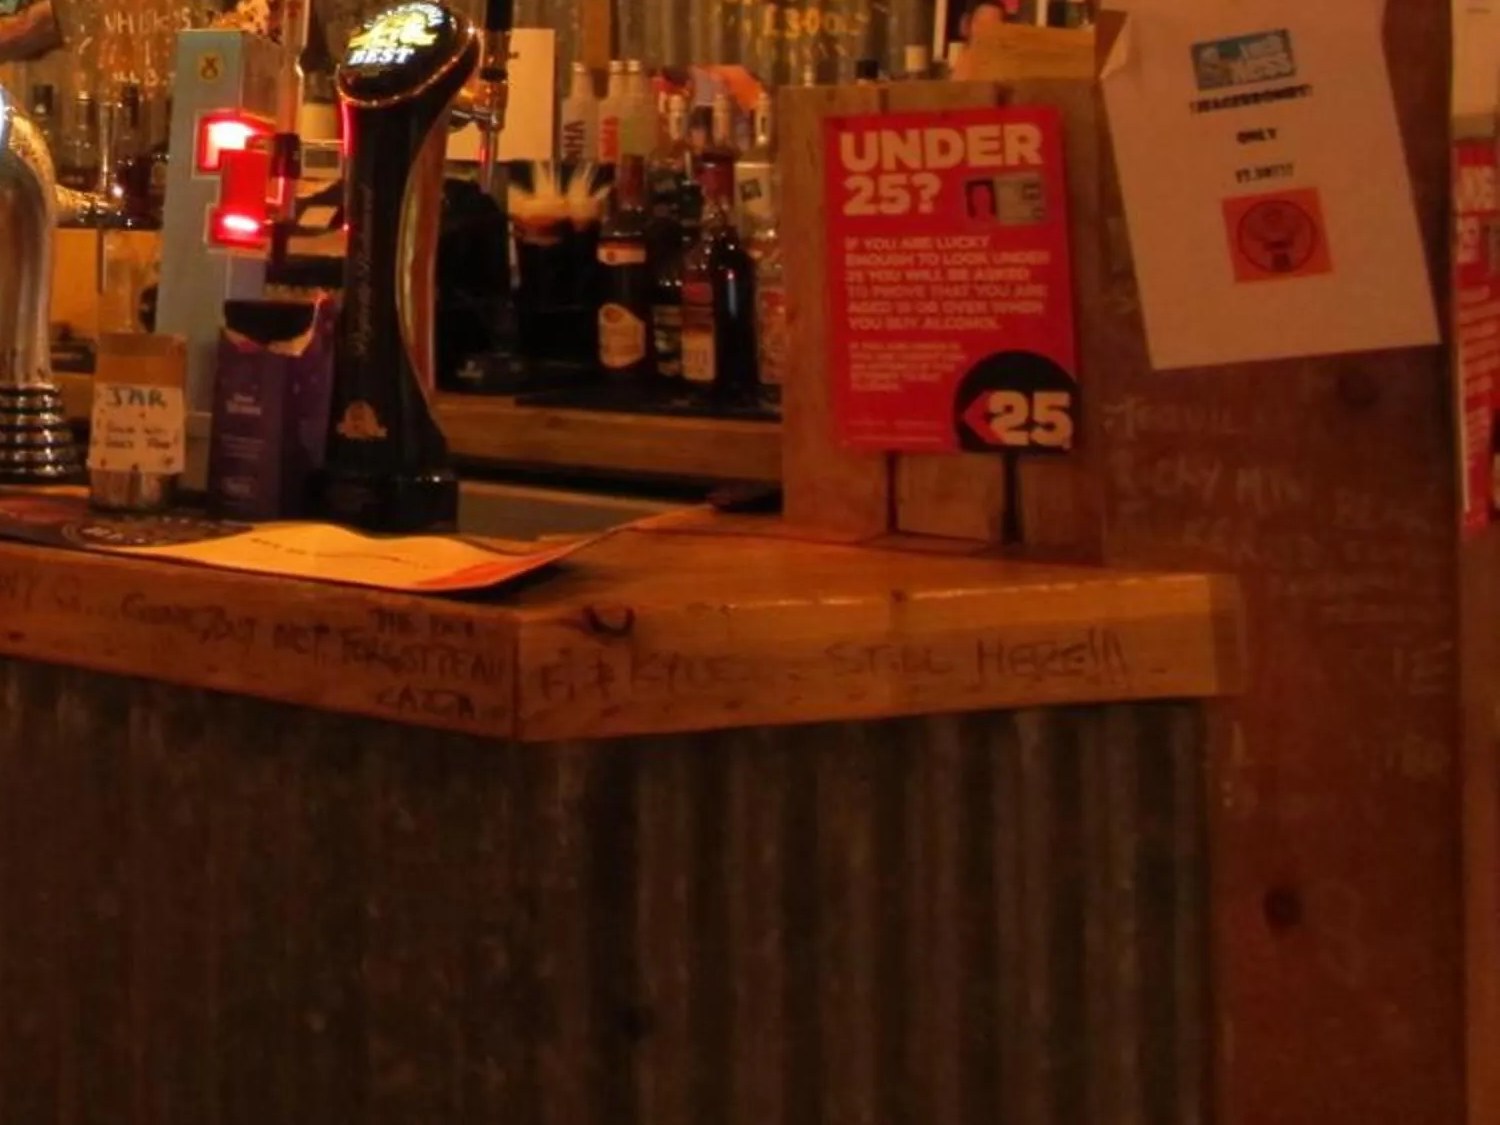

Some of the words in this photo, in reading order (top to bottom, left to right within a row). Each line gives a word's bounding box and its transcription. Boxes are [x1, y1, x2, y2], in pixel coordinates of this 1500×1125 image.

[347, 47, 416, 67] BEST
[838, 121, 1044, 173] UNDER
[841, 171, 943, 217] 25?
[863, 236, 897, 251] YOU
[935, 234, 991, 250] LUCKY
[942, 252, 989, 267] LOOK
[848, 317, 883, 332] YOU
[986, 388, 1073, 451] 25
